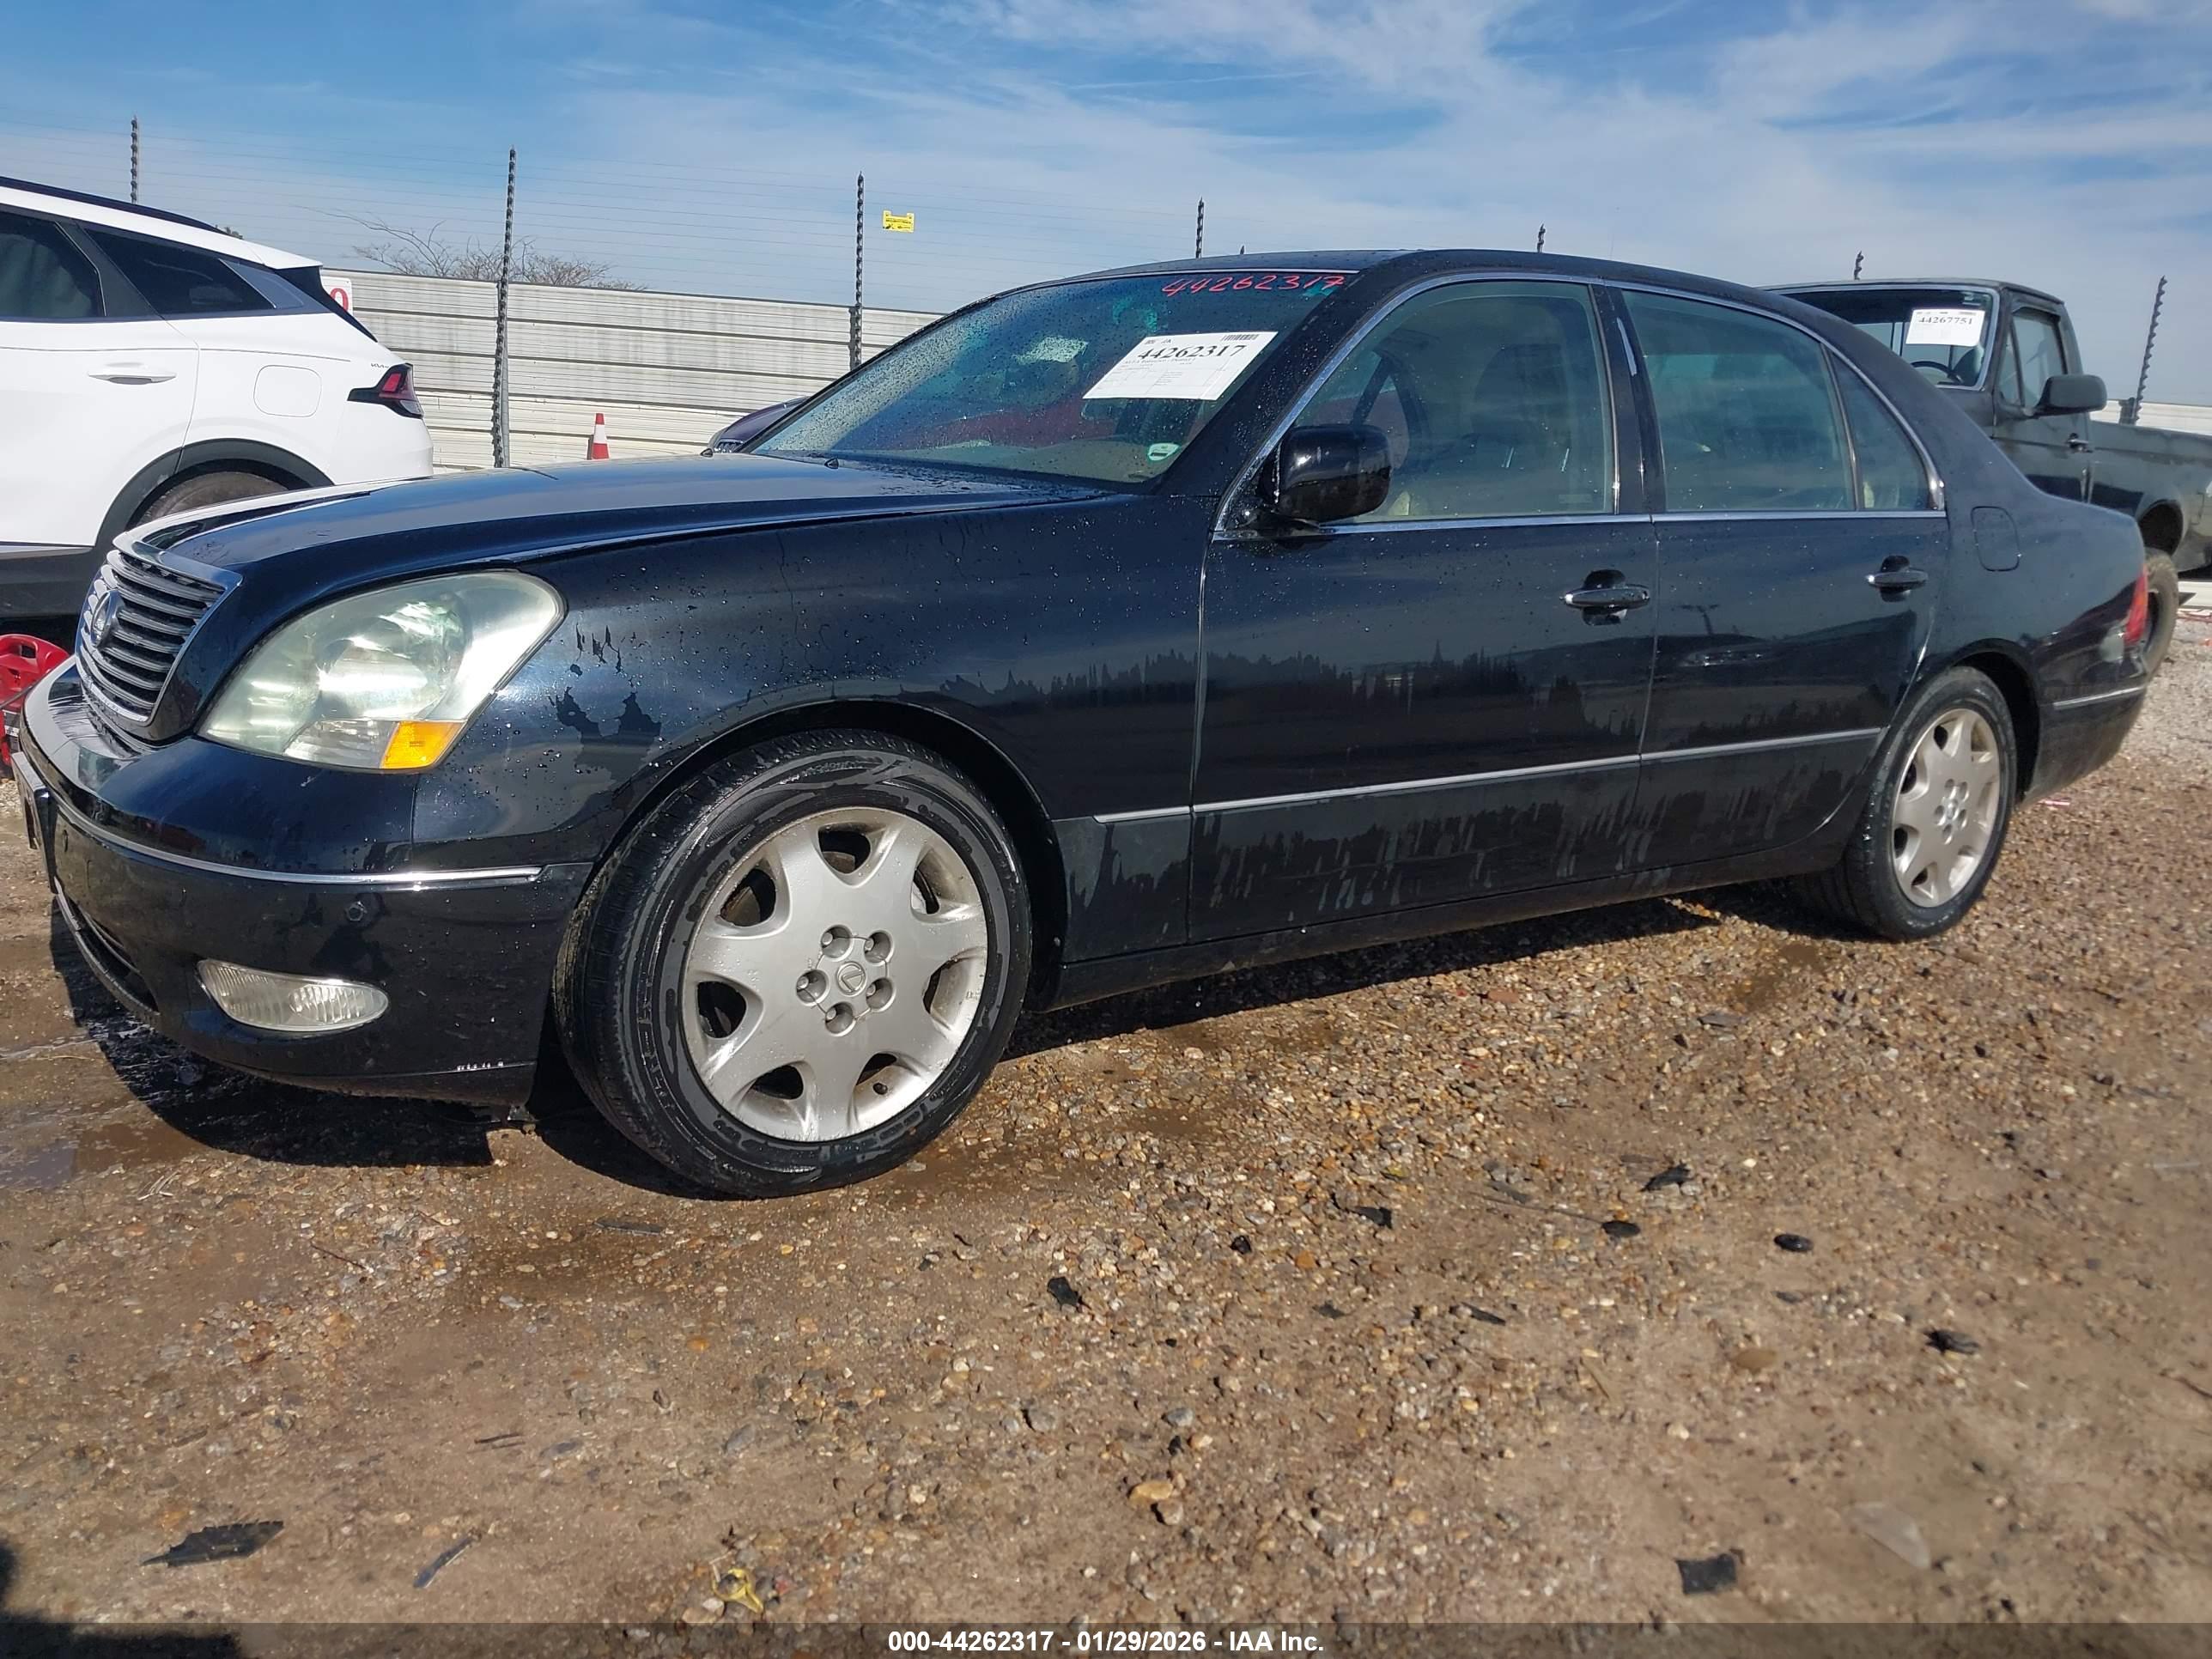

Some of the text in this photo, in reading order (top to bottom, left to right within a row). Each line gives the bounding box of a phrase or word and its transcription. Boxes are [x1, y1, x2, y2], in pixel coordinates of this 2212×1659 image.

[1162, 275, 1345, 296] 44262317
[1918, 316, 1973, 325] 44267751
[1138, 344, 1247, 359] 44262317
